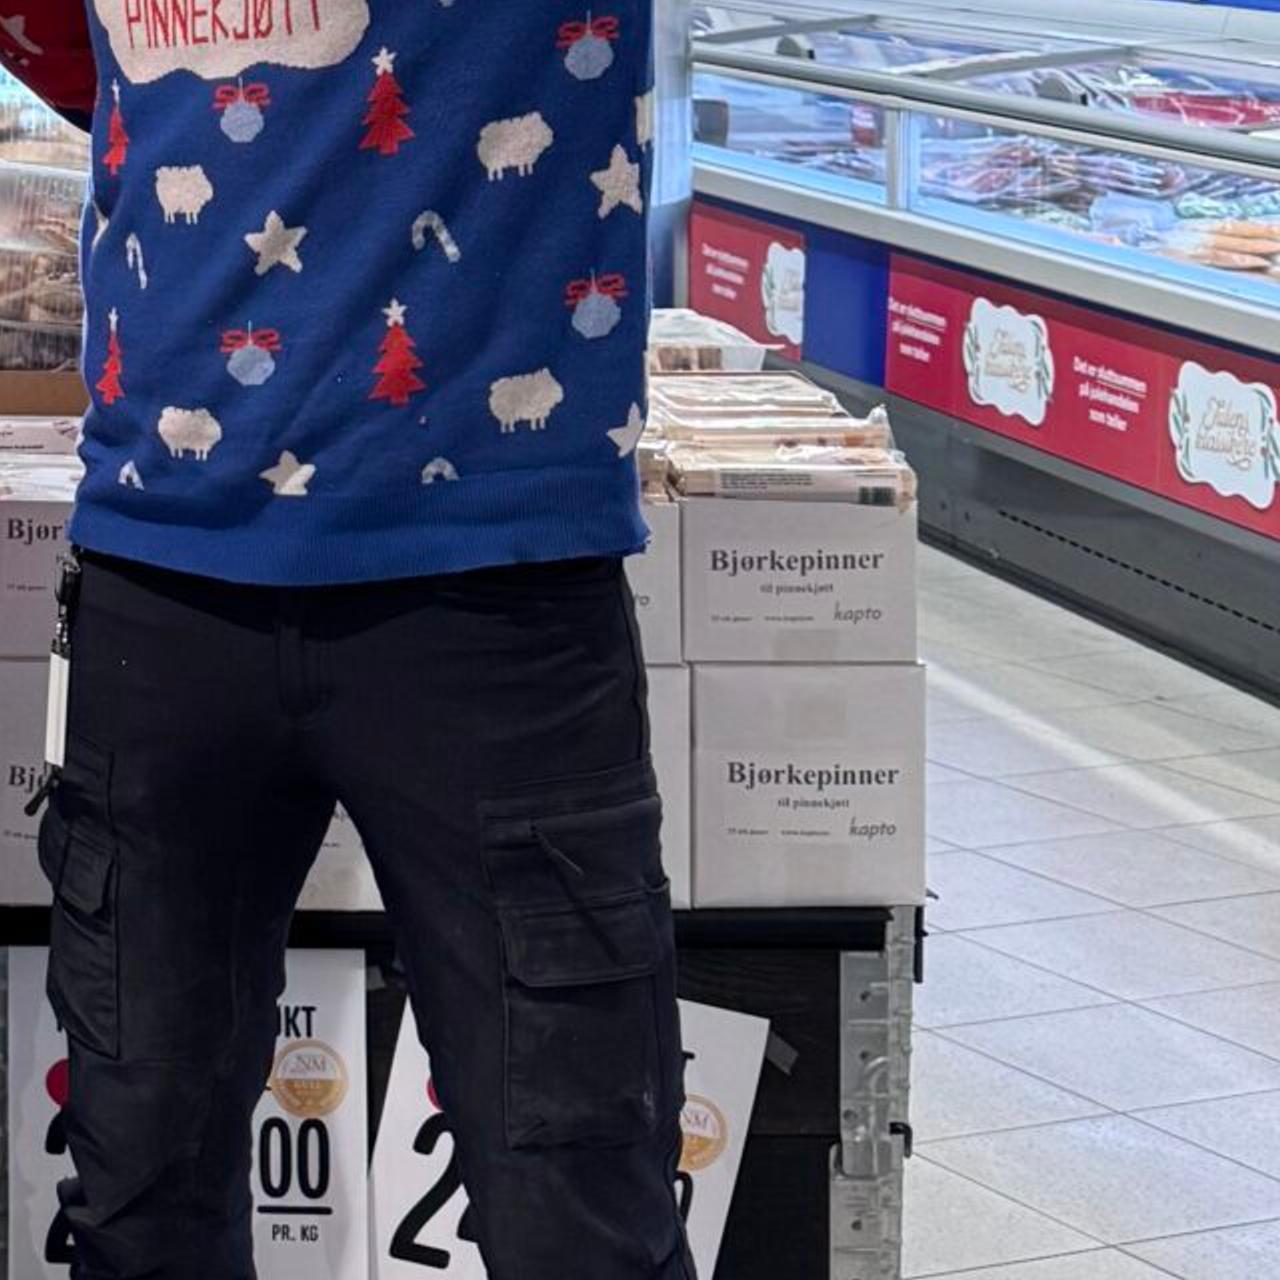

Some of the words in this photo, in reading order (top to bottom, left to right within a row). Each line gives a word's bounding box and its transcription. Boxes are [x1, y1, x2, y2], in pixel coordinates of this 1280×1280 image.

[711, 549, 884, 577] Bjørkepinner
[834, 601, 883, 625] kapto
[727, 761, 900, 790] Bjørkepinner
[849, 817, 897, 840] kapto
[258, 1117, 330, 1199] 00
[272, 1224, 297, 1242] PR.
[300, 1224, 319, 1242] KG
